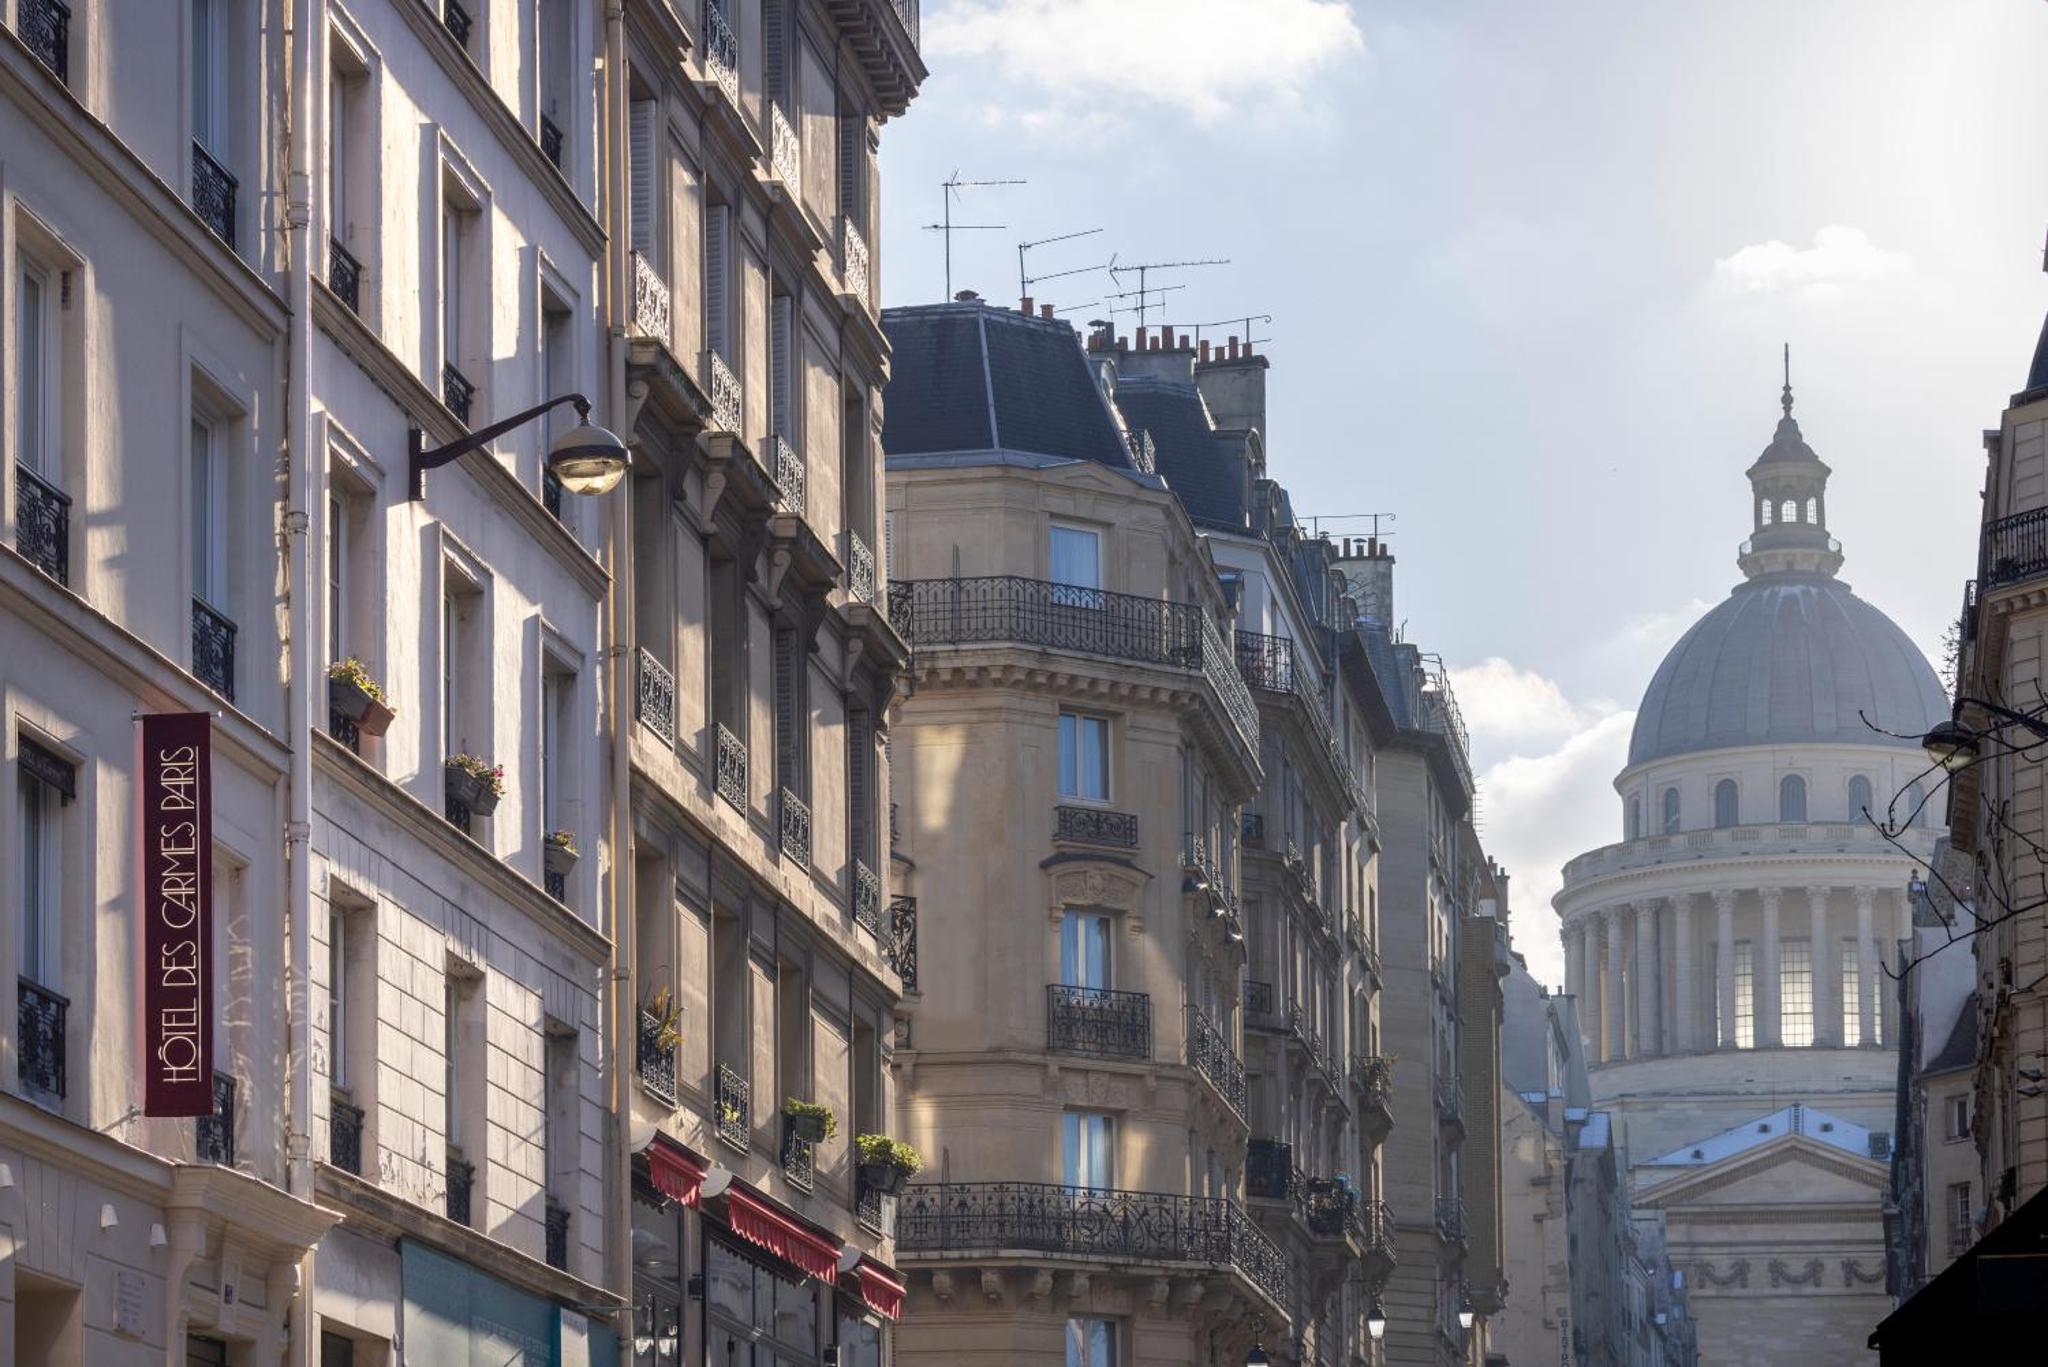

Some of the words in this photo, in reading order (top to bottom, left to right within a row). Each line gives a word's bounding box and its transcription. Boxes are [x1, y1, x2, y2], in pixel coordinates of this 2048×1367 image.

[160, 746, 194, 810] PARIS
[160, 821, 195, 929] CARMES
[161, 940, 196, 987] DES
[157, 998, 197, 1083] HÔTEL
